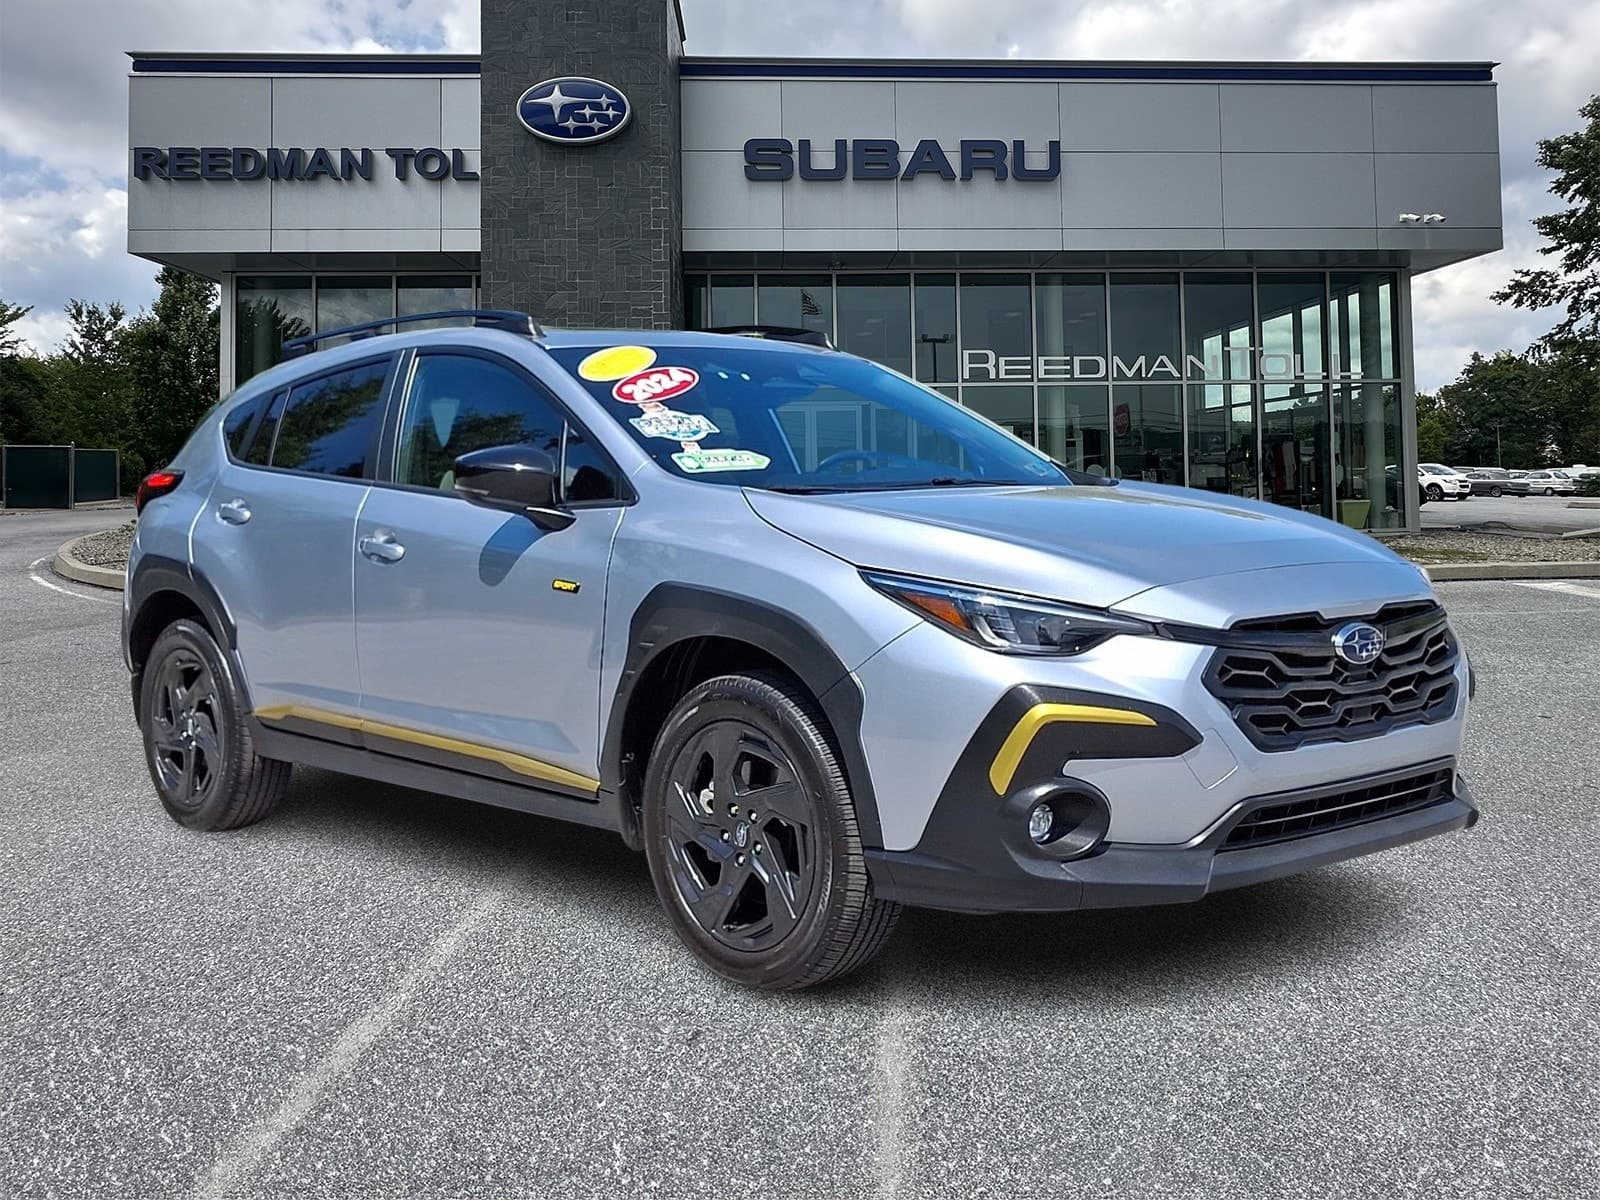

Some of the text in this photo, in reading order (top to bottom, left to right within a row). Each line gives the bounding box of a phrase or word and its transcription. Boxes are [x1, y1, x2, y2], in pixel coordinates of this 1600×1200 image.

[134, 147, 374, 181] REEDMAN
[744, 138, 1061, 181] SUBARU
[963, 349, 1218, 379] REEDMAN
[621, 369, 694, 401] 2024
